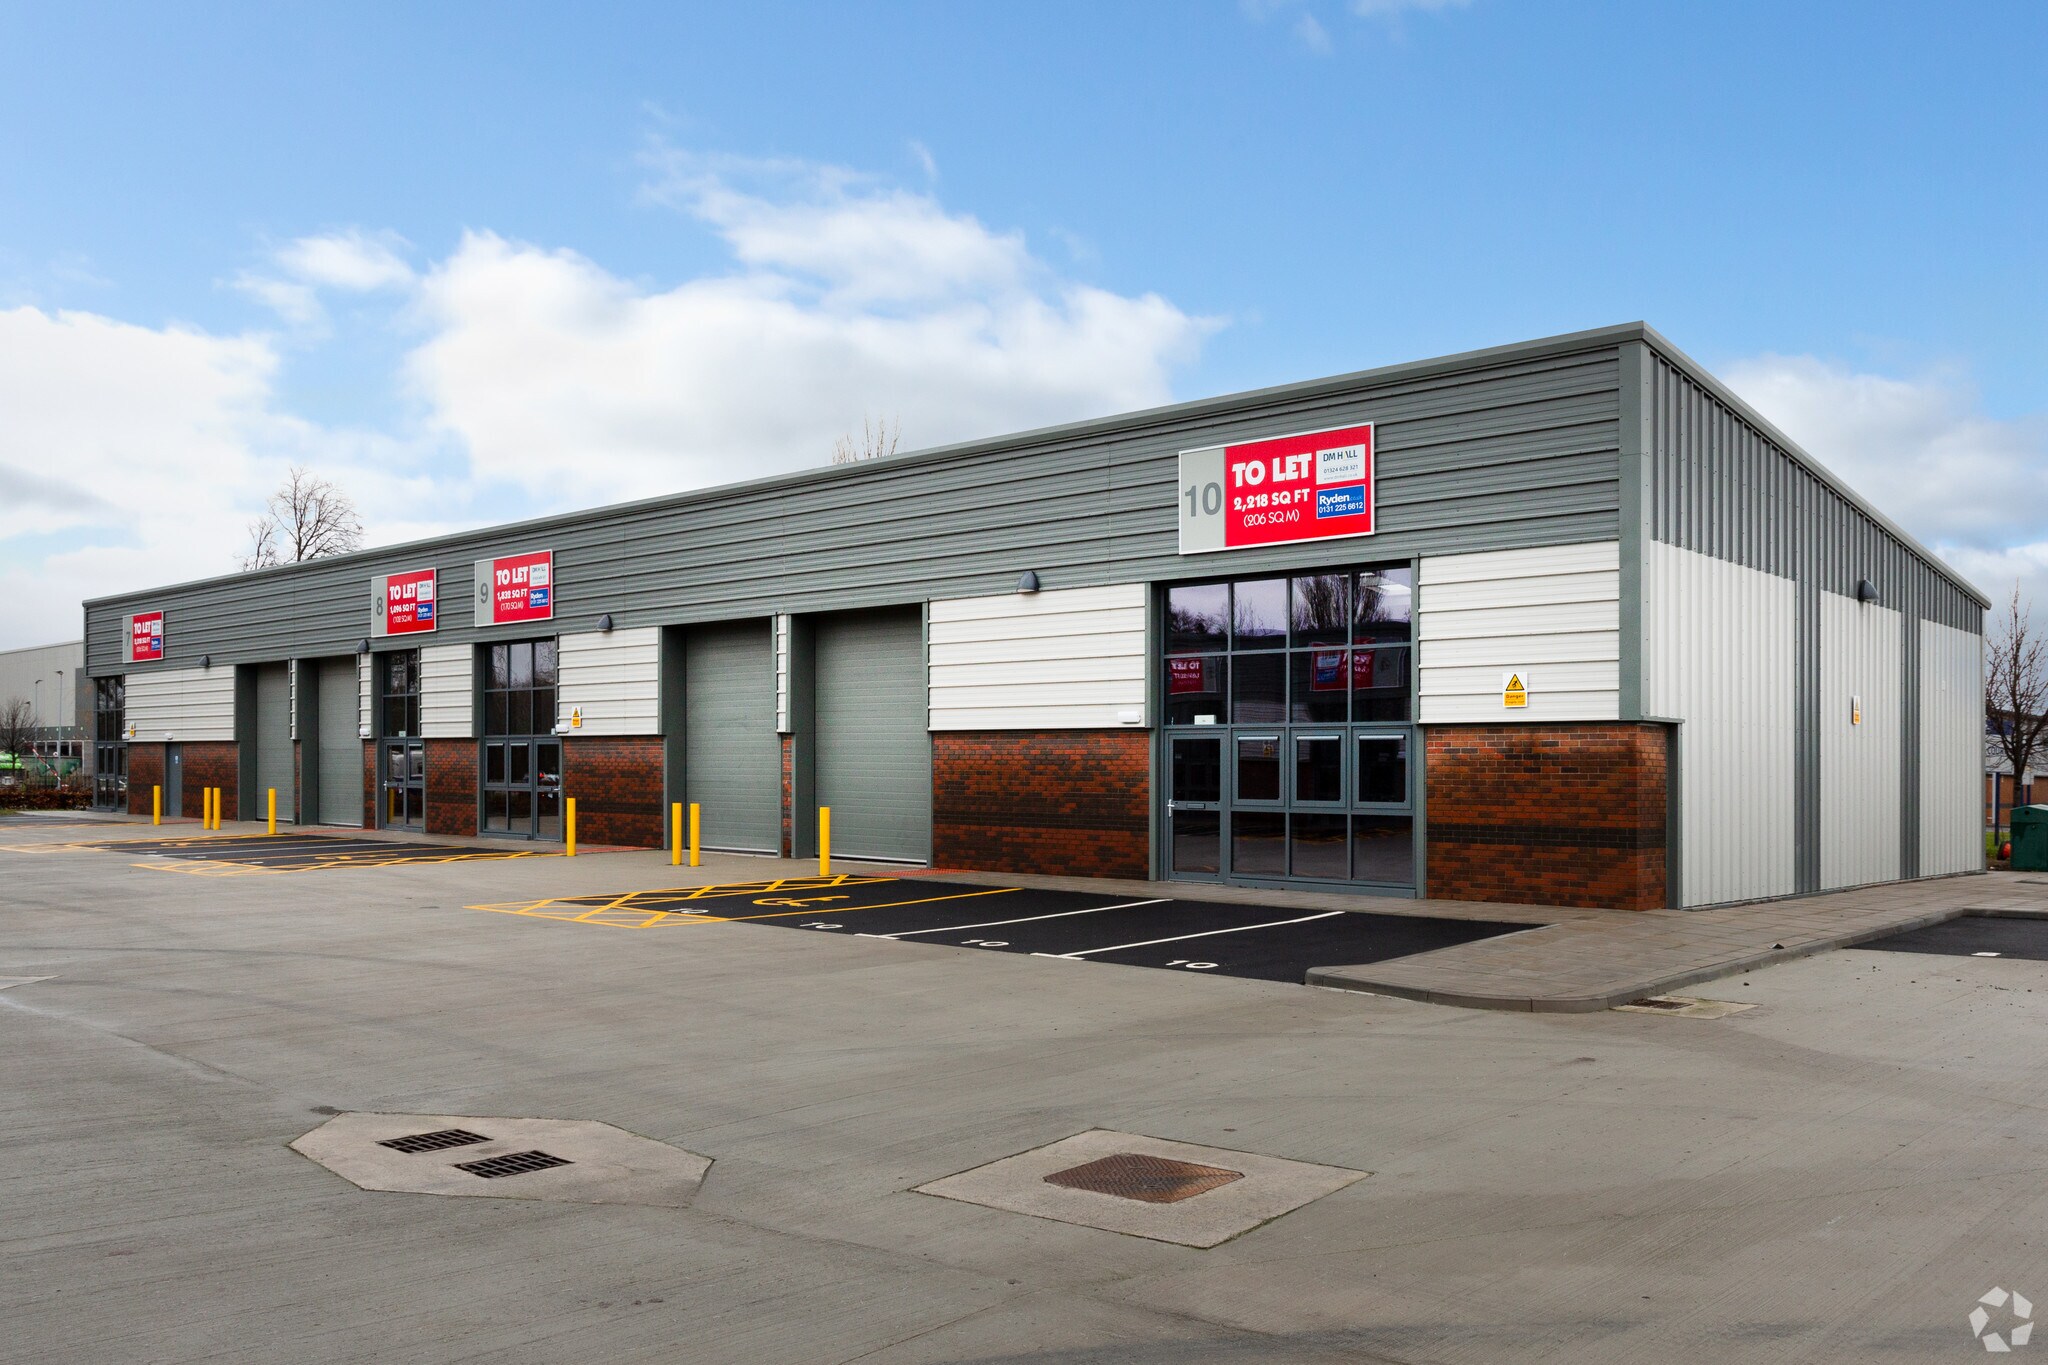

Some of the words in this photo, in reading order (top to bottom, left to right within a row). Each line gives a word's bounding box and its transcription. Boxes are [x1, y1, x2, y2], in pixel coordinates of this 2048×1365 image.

[1323, 453, 1336, 462] DM
[1337, 449, 1358, 460] HALL
[1232, 459, 1266, 488] TO
[1272, 452, 1312, 482] LET
[1184, 481, 1222, 517] 10
[1233, 493, 1269, 513] 2,218
[1271, 490, 1292, 506] SQ
[1294, 488, 1311, 503] FT
[1319, 505, 1334, 513] 0131
[1335, 503, 1347, 512] 225
[1347, 501, 1364, 510] 6612
[1243, 512, 1267, 528] (206
[1268, 511, 1285, 524] SQ
[1285, 508, 1300, 523] M)
[496, 568, 511, 586] TO
[512, 566, 528, 583] LET
[389, 584, 402, 600] TO
[403, 583, 416, 599] LET
[480, 582, 489, 604] 9
[512, 589, 520, 599] SQ
[521, 588, 527, 597] FT
[376, 596, 384, 617] 8
[410, 602, 416, 612] FT
[134, 622, 142, 634] TO
[142, 621, 151, 633] LET
[126, 631, 131, 647] 7
[961, 939, 1009, 947] 10
[1165, 960, 1219, 969] 10
